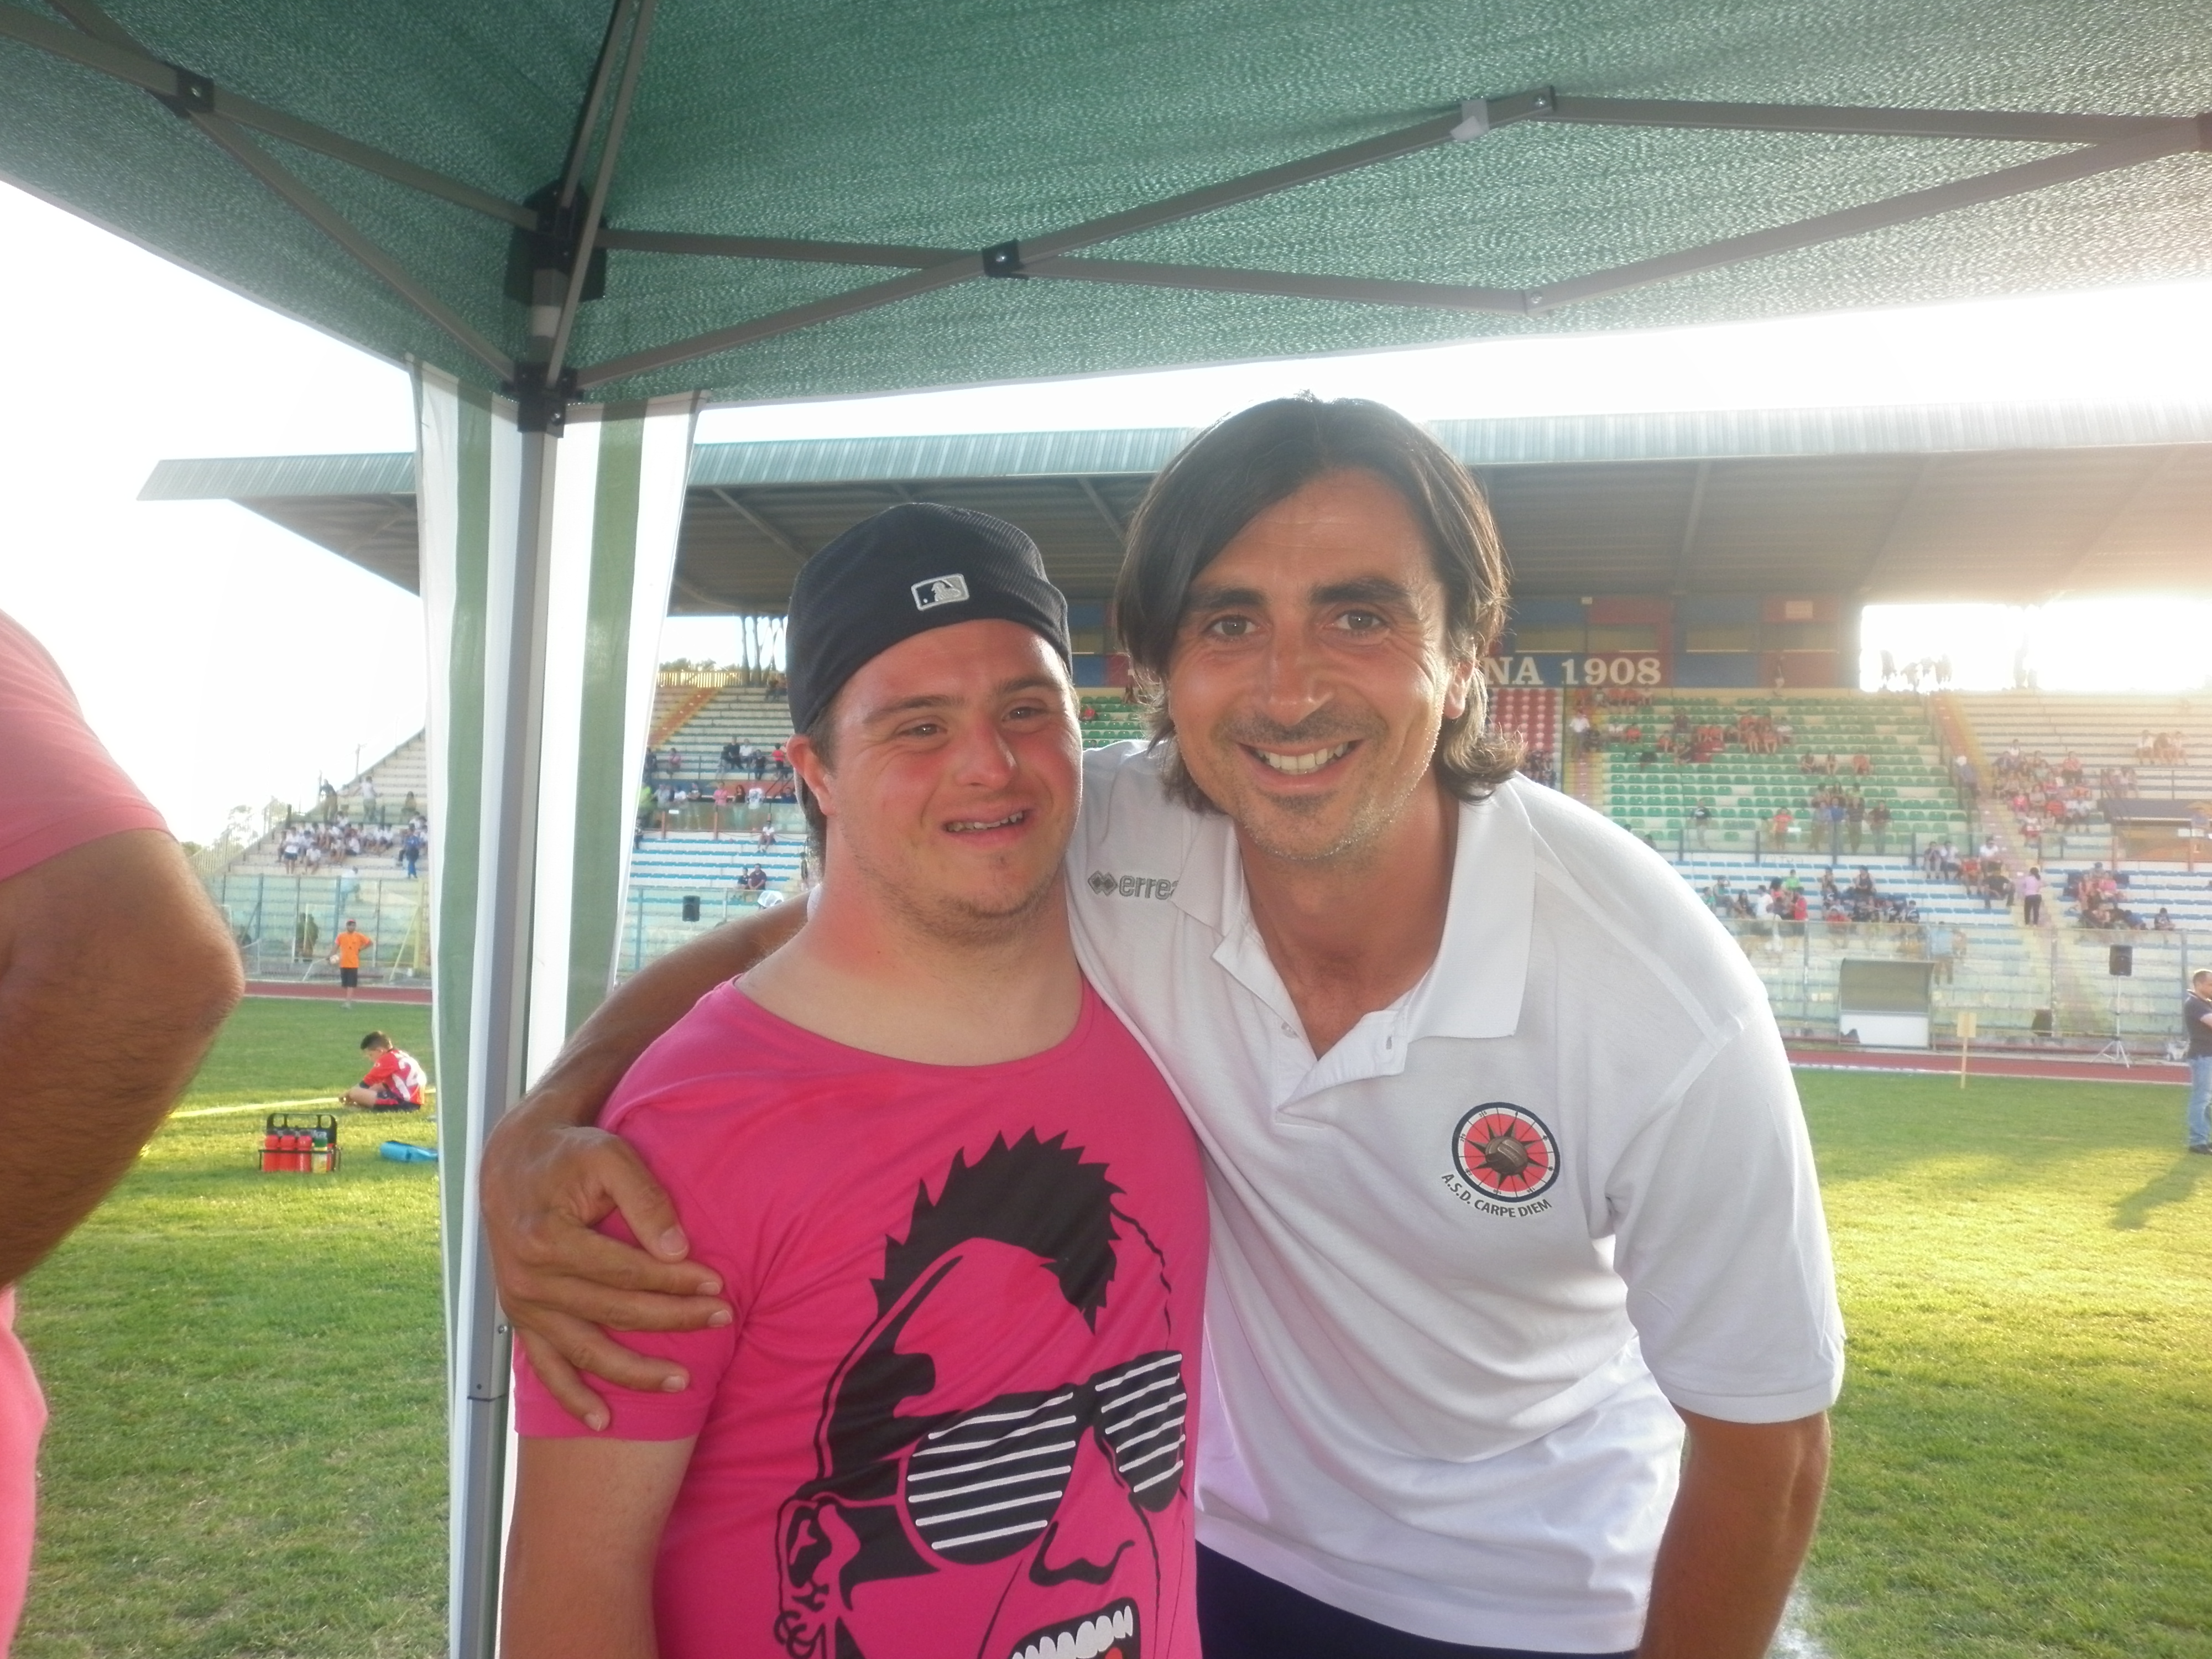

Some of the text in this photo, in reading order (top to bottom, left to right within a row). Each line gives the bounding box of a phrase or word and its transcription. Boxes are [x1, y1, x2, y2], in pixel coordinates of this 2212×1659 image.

[1562, 657, 1661, 685] 1908
[1119, 875, 1179, 900] erre
[1441, 1173, 1552, 1218] A.S.D. CARPE DIEM
